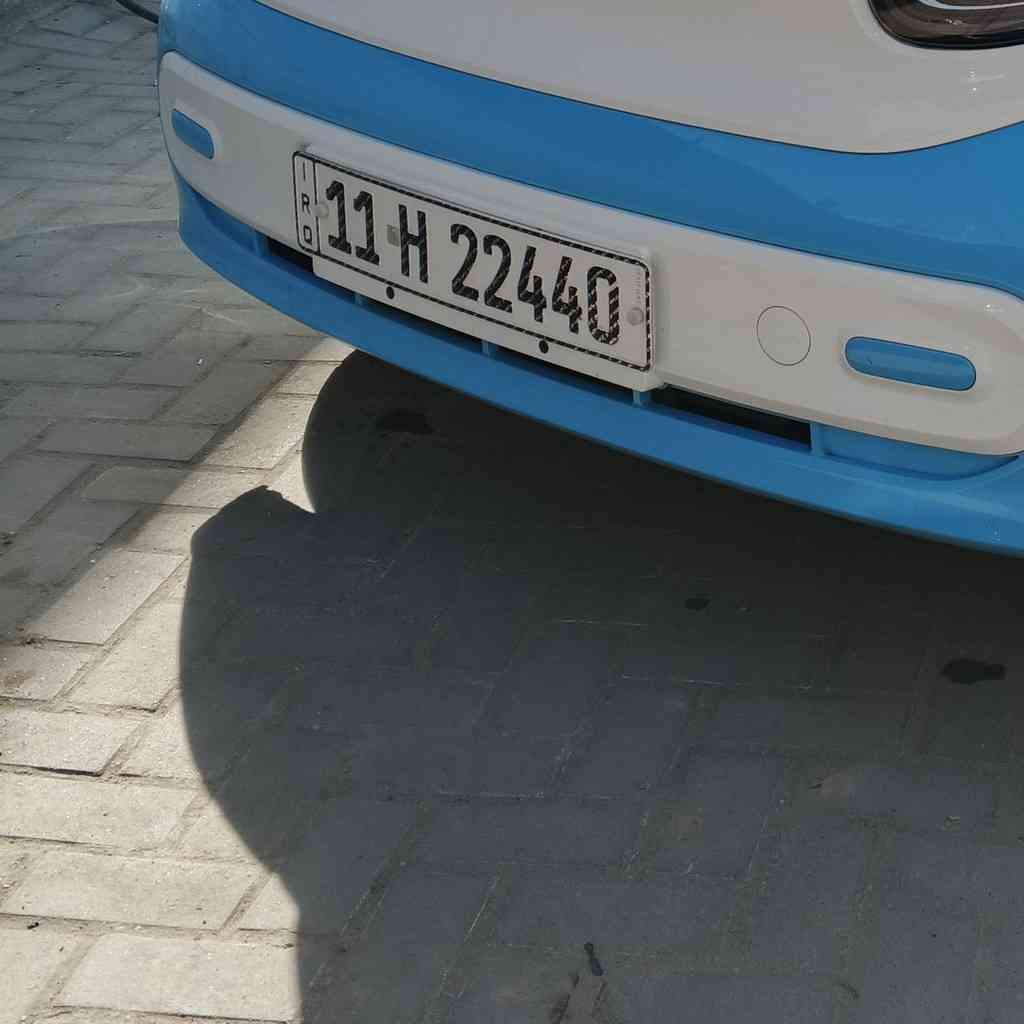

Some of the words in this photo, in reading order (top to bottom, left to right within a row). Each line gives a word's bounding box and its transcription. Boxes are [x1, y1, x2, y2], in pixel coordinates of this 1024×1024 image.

[325, 180, 380, 266] 11
[398, 203, 429, 284] H
[450, 223, 620, 346] 22440
